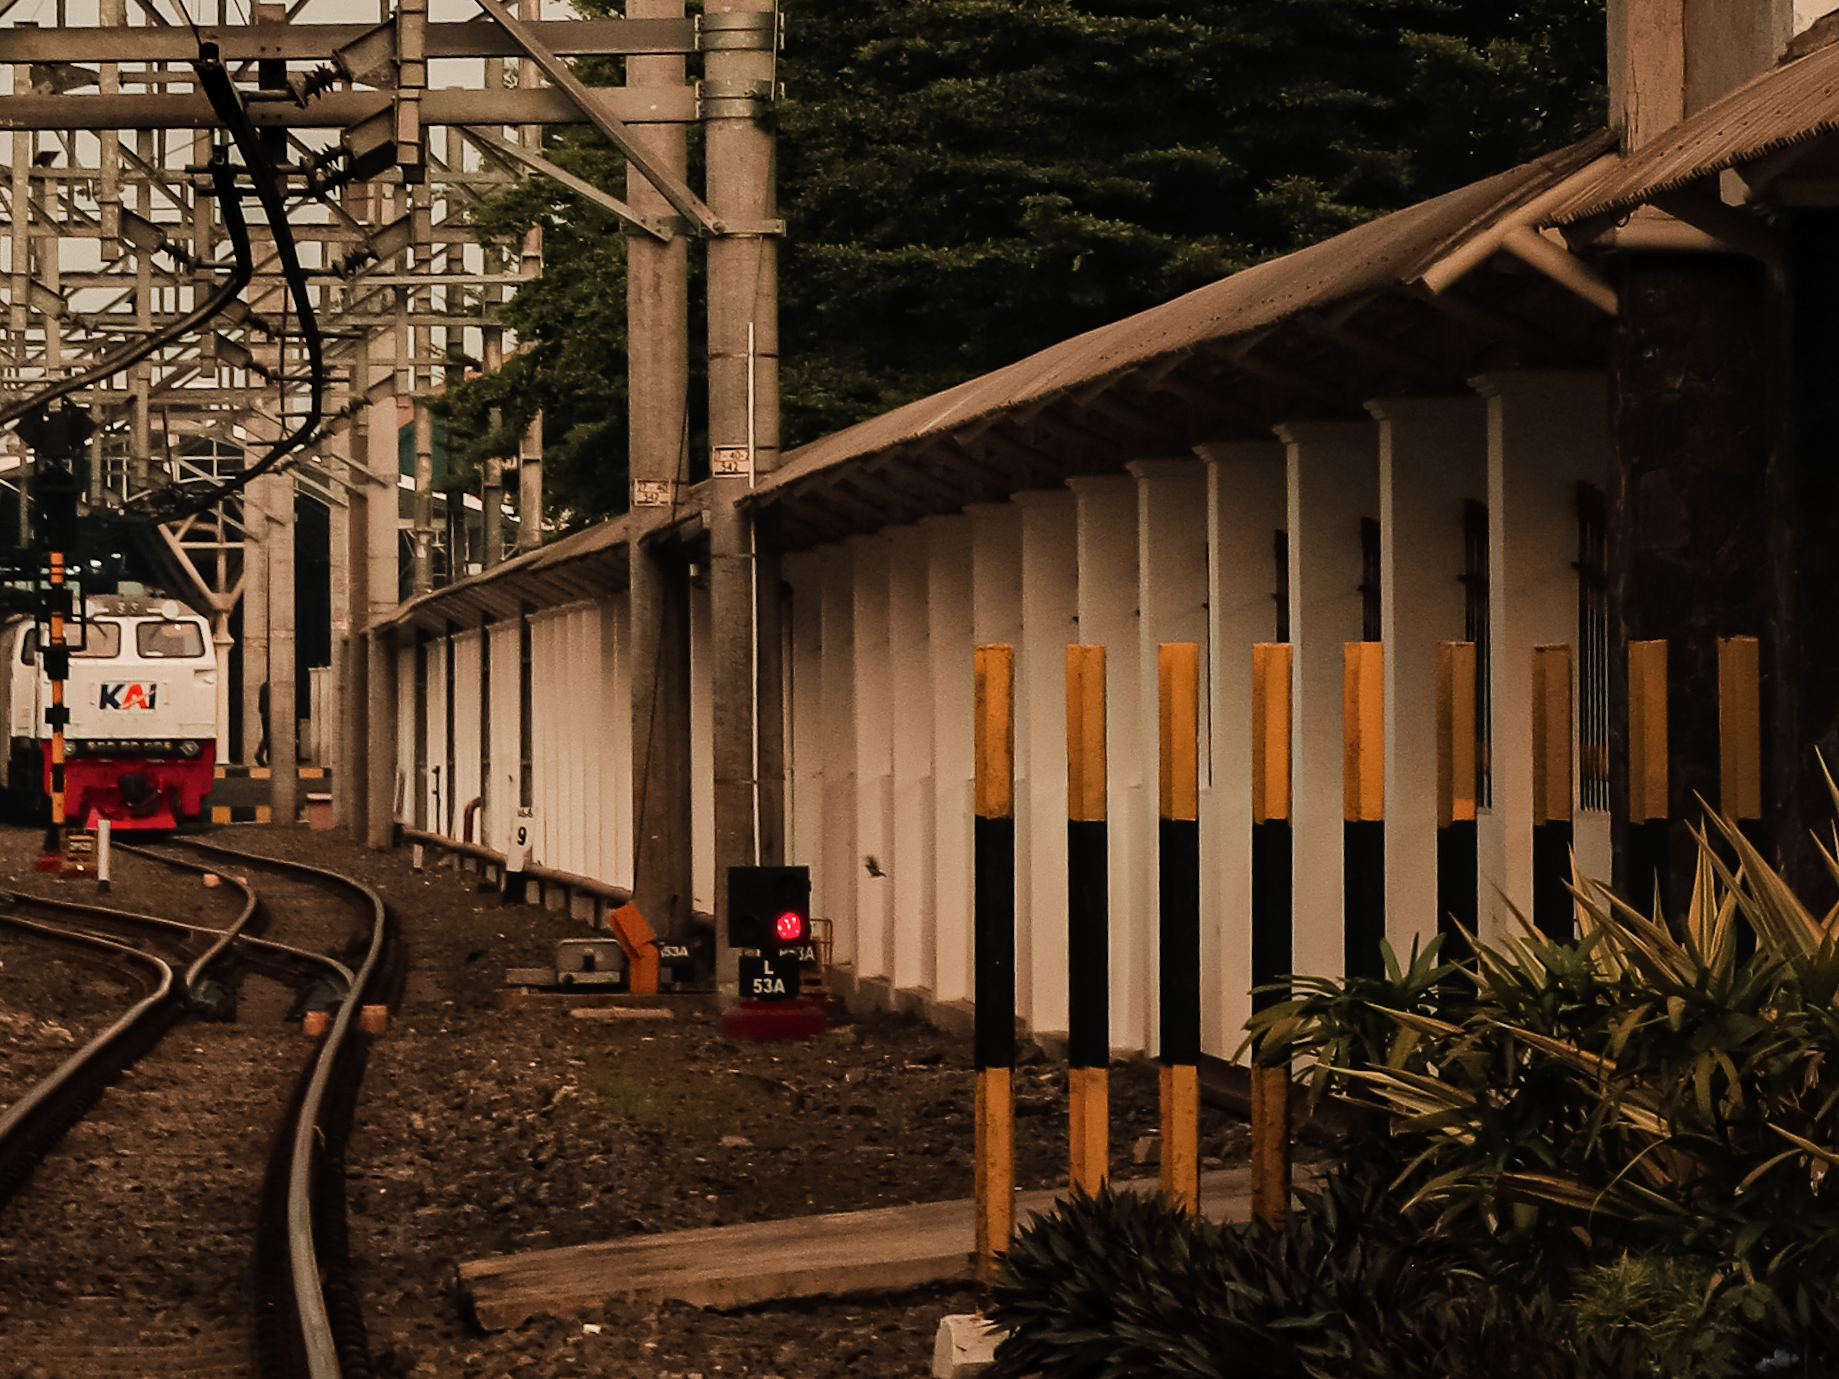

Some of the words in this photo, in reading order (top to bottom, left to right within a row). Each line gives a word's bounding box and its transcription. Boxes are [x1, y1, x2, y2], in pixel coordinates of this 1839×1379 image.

[100, 684, 156, 709] KAI
[517, 826, 526, 845] 9
[763, 960, 774, 975] L
[752, 977, 787, 994] 53A
